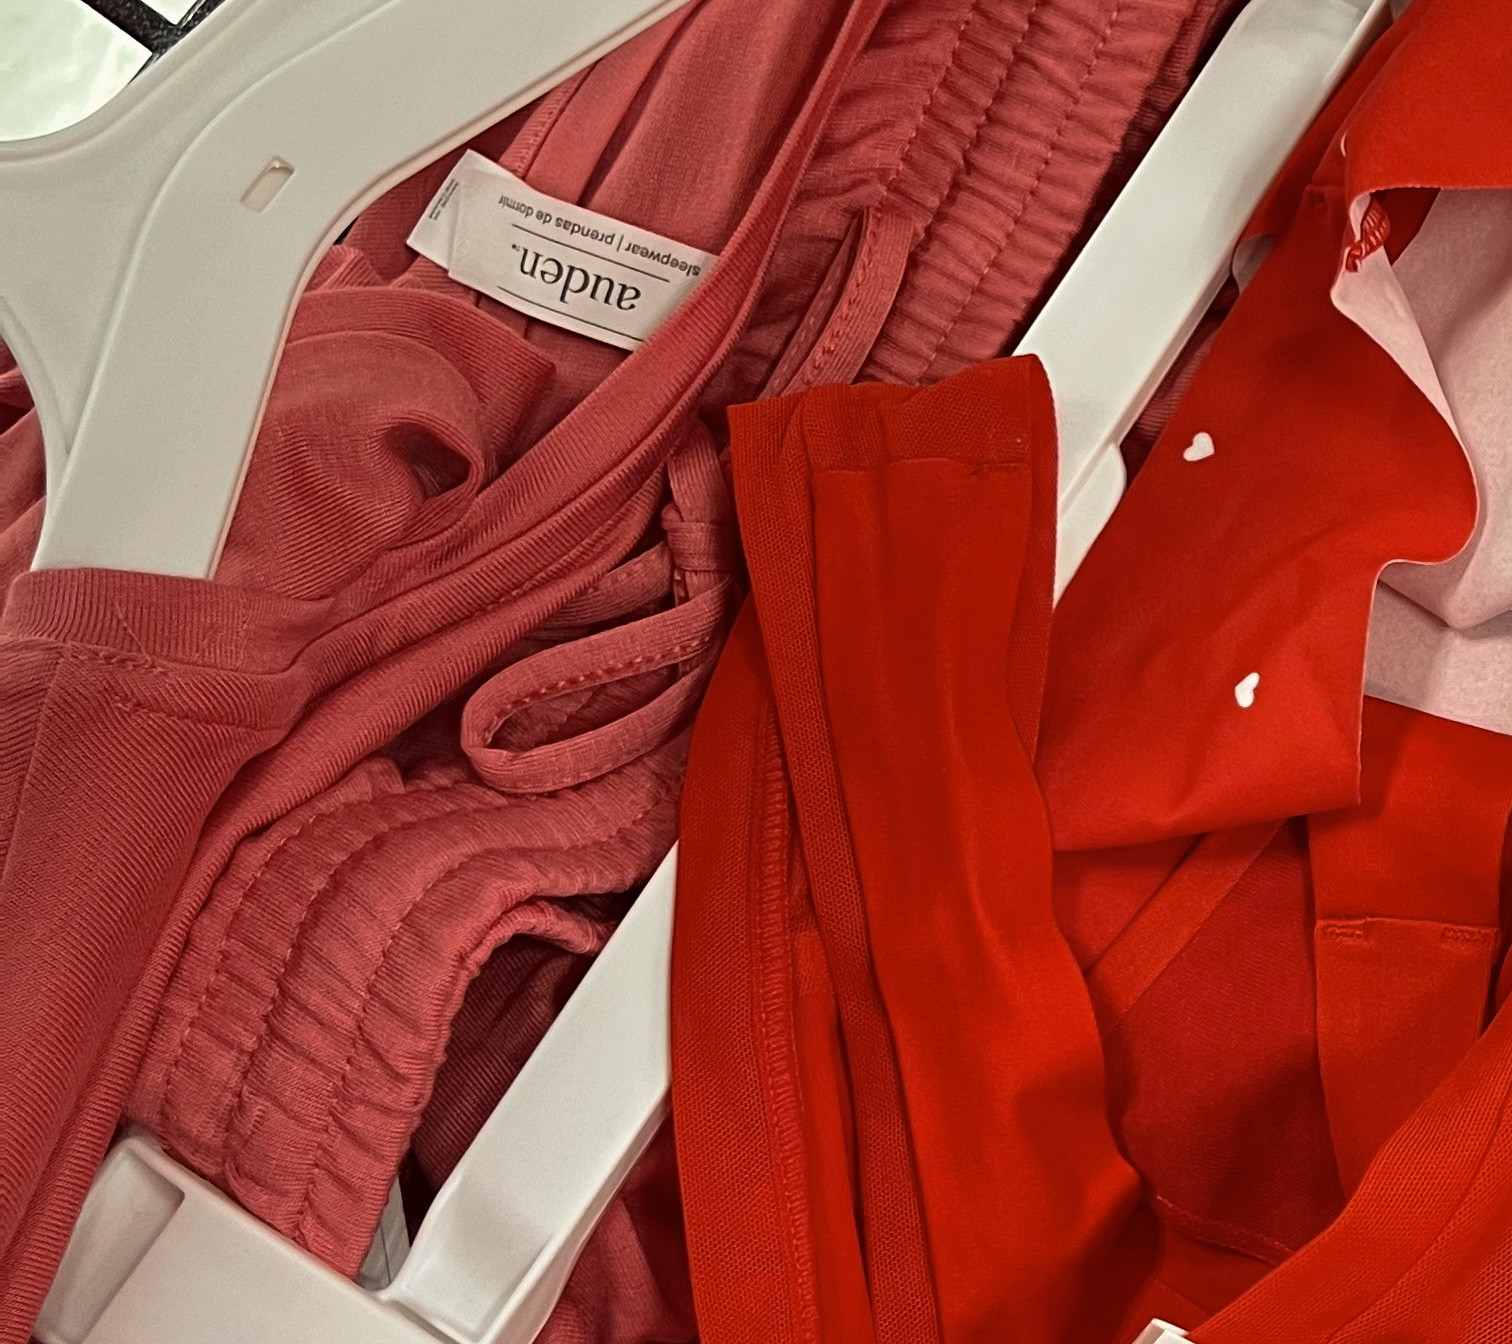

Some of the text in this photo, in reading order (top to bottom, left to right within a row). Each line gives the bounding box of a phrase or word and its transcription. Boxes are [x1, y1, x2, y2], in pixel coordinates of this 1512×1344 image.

[498, 195, 535, 219] dormir
[535, 209, 553, 225] de
[555, 217, 616, 244] prendas
[624, 239, 702, 277] sleepwear
[519, 248, 642, 312] auden
